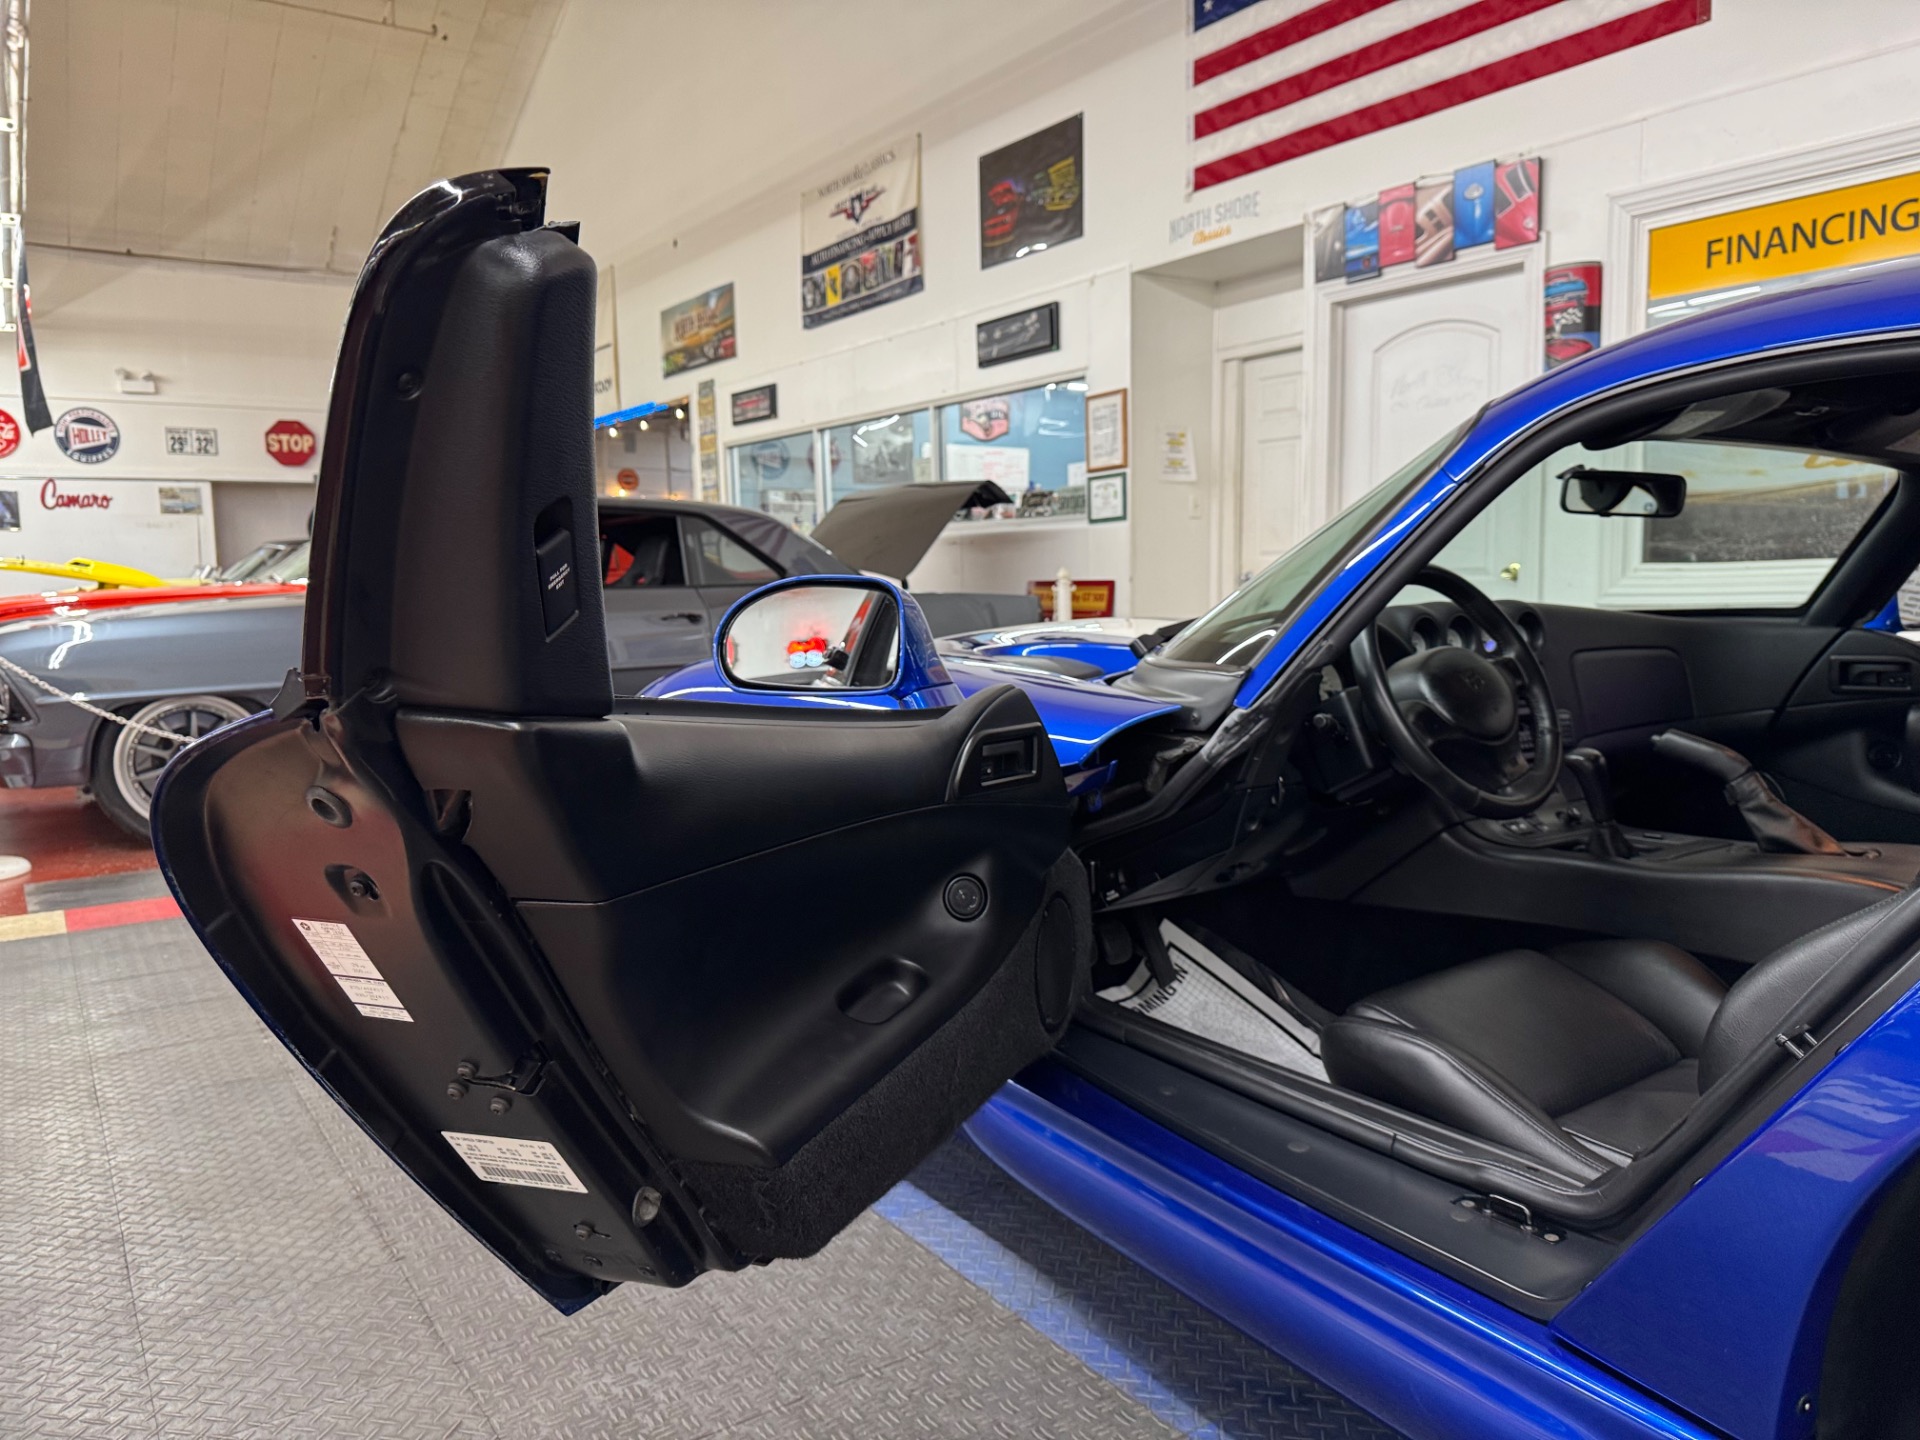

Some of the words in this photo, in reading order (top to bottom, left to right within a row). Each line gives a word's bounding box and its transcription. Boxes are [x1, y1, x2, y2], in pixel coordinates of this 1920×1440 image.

[1169, 206, 1211, 243] NORTH
[1214, 191, 1259, 223] SHORE
[1705, 198, 1920, 269] FINANCING
[266, 434, 314, 453] STOP
[40, 478, 113, 509] Camaro
